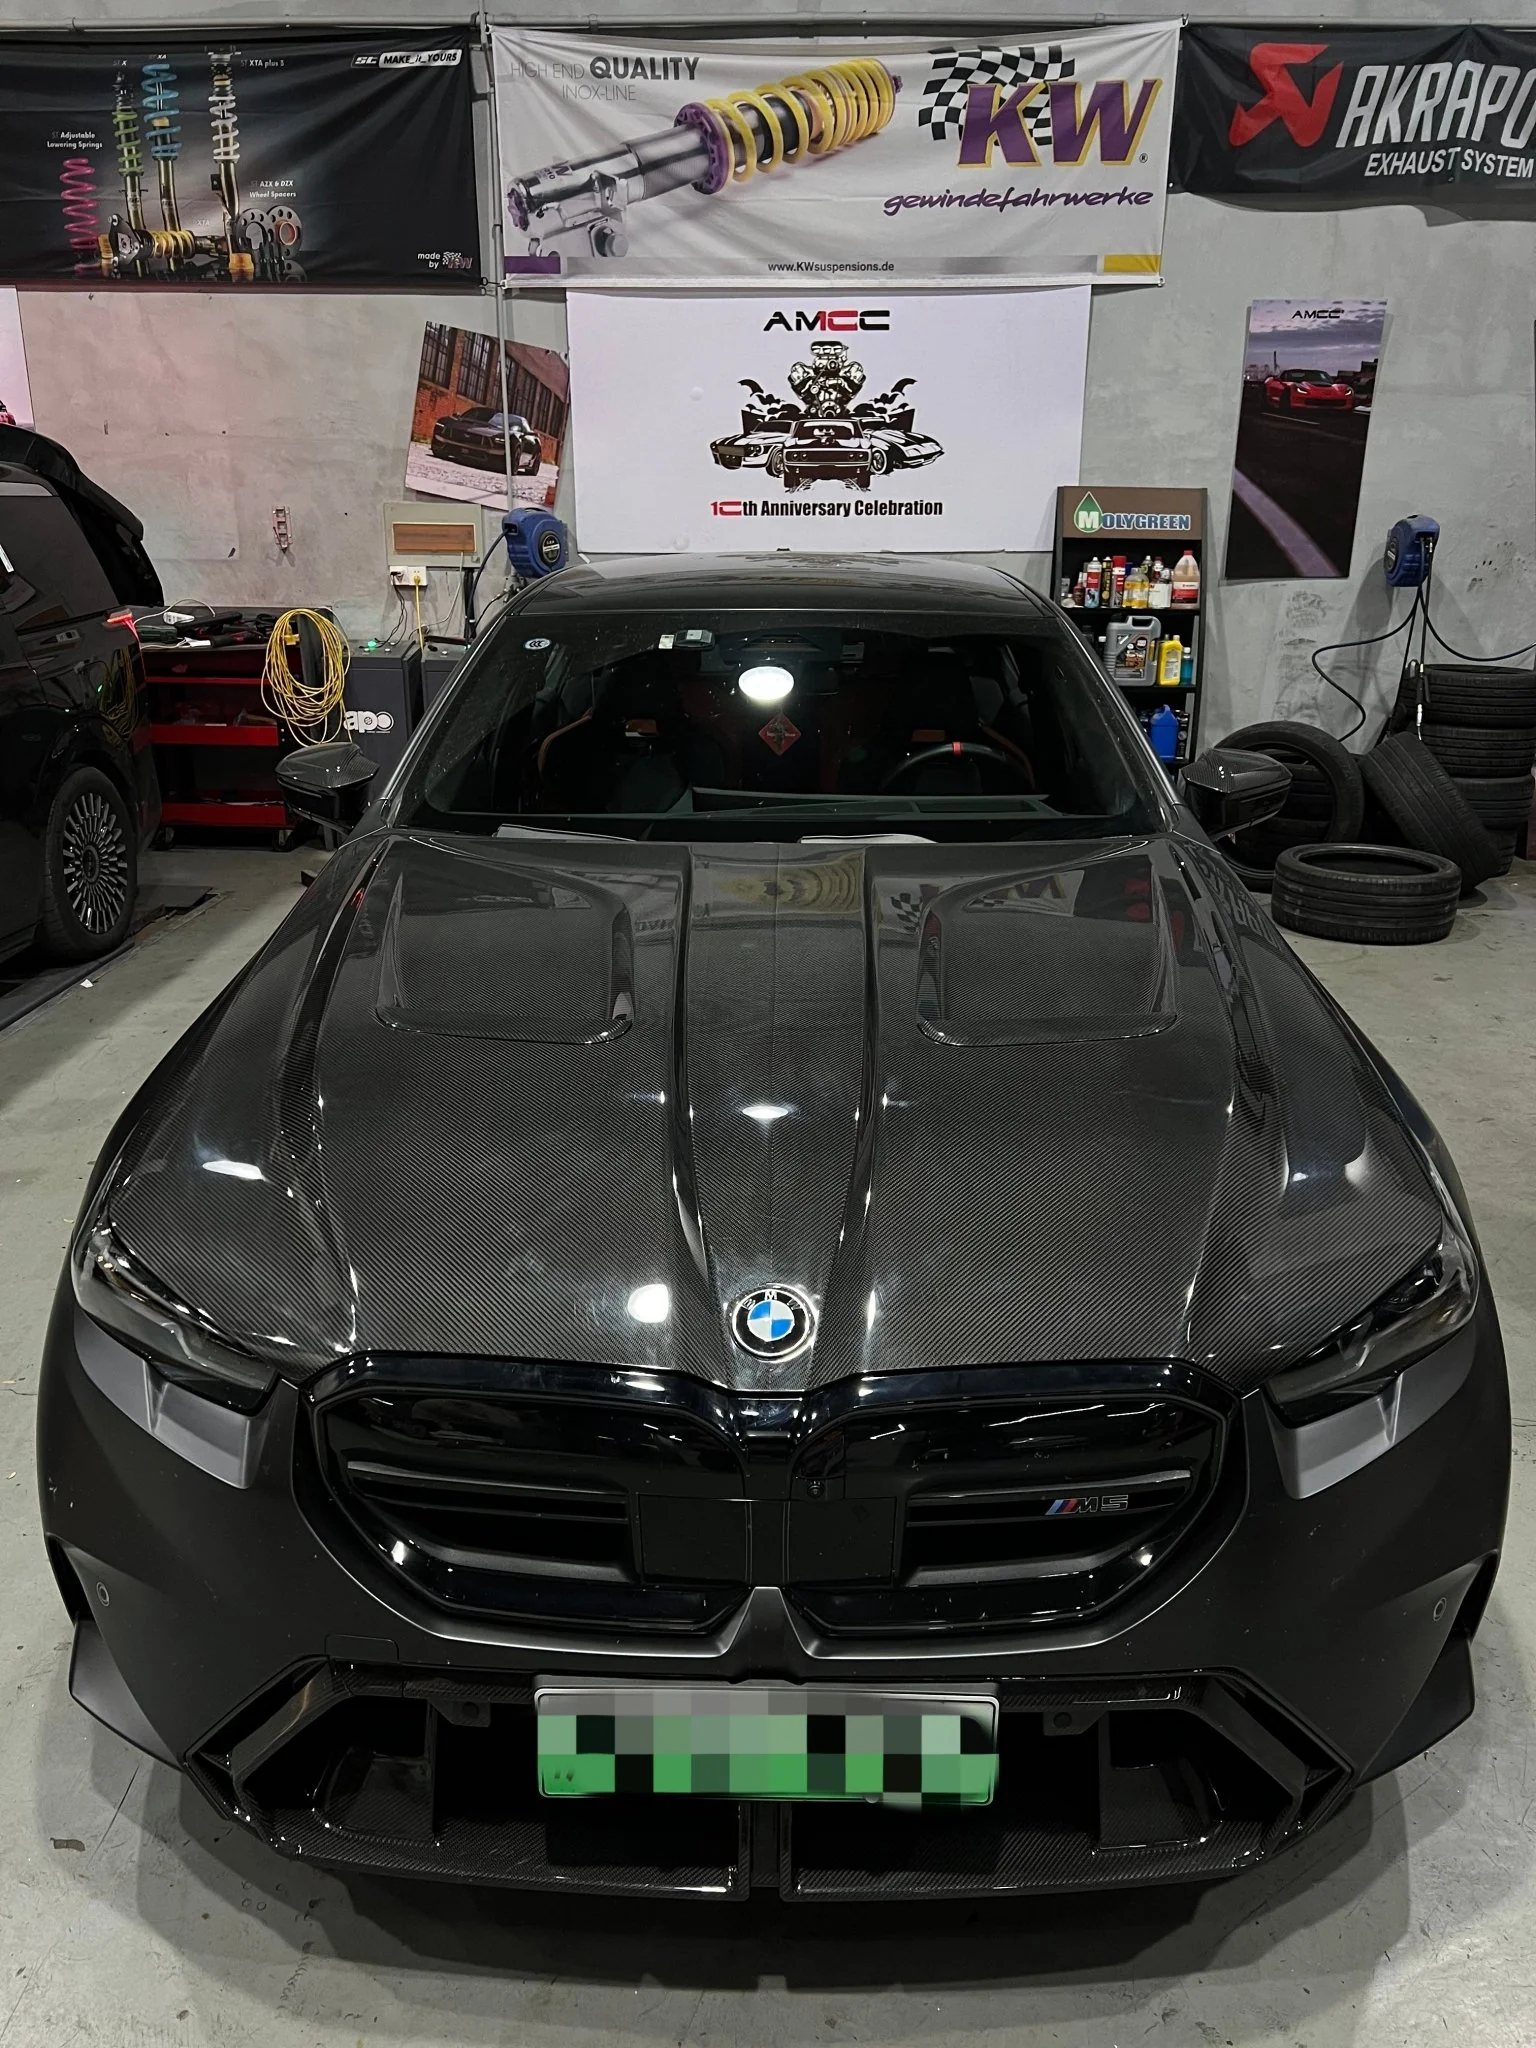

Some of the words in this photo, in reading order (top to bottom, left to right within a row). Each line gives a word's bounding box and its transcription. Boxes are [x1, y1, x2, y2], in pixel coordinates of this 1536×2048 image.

[250, 59, 263, 67] XTA
[511, 62, 548, 79] HIGH
[552, 63, 584, 79] END
[589, 56, 700, 81] QUALITY
[562, 84, 637, 101] INOX-LINE
[957, 79, 1163, 168] KW
[60, 131, 96, 140] Adjustable
[47, 140, 77, 149] Lowering
[78, 140, 103, 149] Springs
[1364, 147, 1461, 177] EXHAUST
[1461, 148, 1535, 178] SYSTEM
[249, 190, 270, 198] Wheel
[270, 190, 297, 200] Spacers
[883, 186, 1154, 217] gewindefahrwerke
[417, 252, 441, 260] made
[428, 260, 440, 270] by
[767, 261, 895, 273] www.KWsuspensions.de
[1291, 309, 1342, 319] AMCC
[760, 500, 851, 518] Anniversary
[854, 500, 943, 516] Celebration
[1077, 510, 1191, 531] MOLYGREEN
[740, 1291, 804, 1311] BMW
[1068, 1494, 1129, 1515] M5
